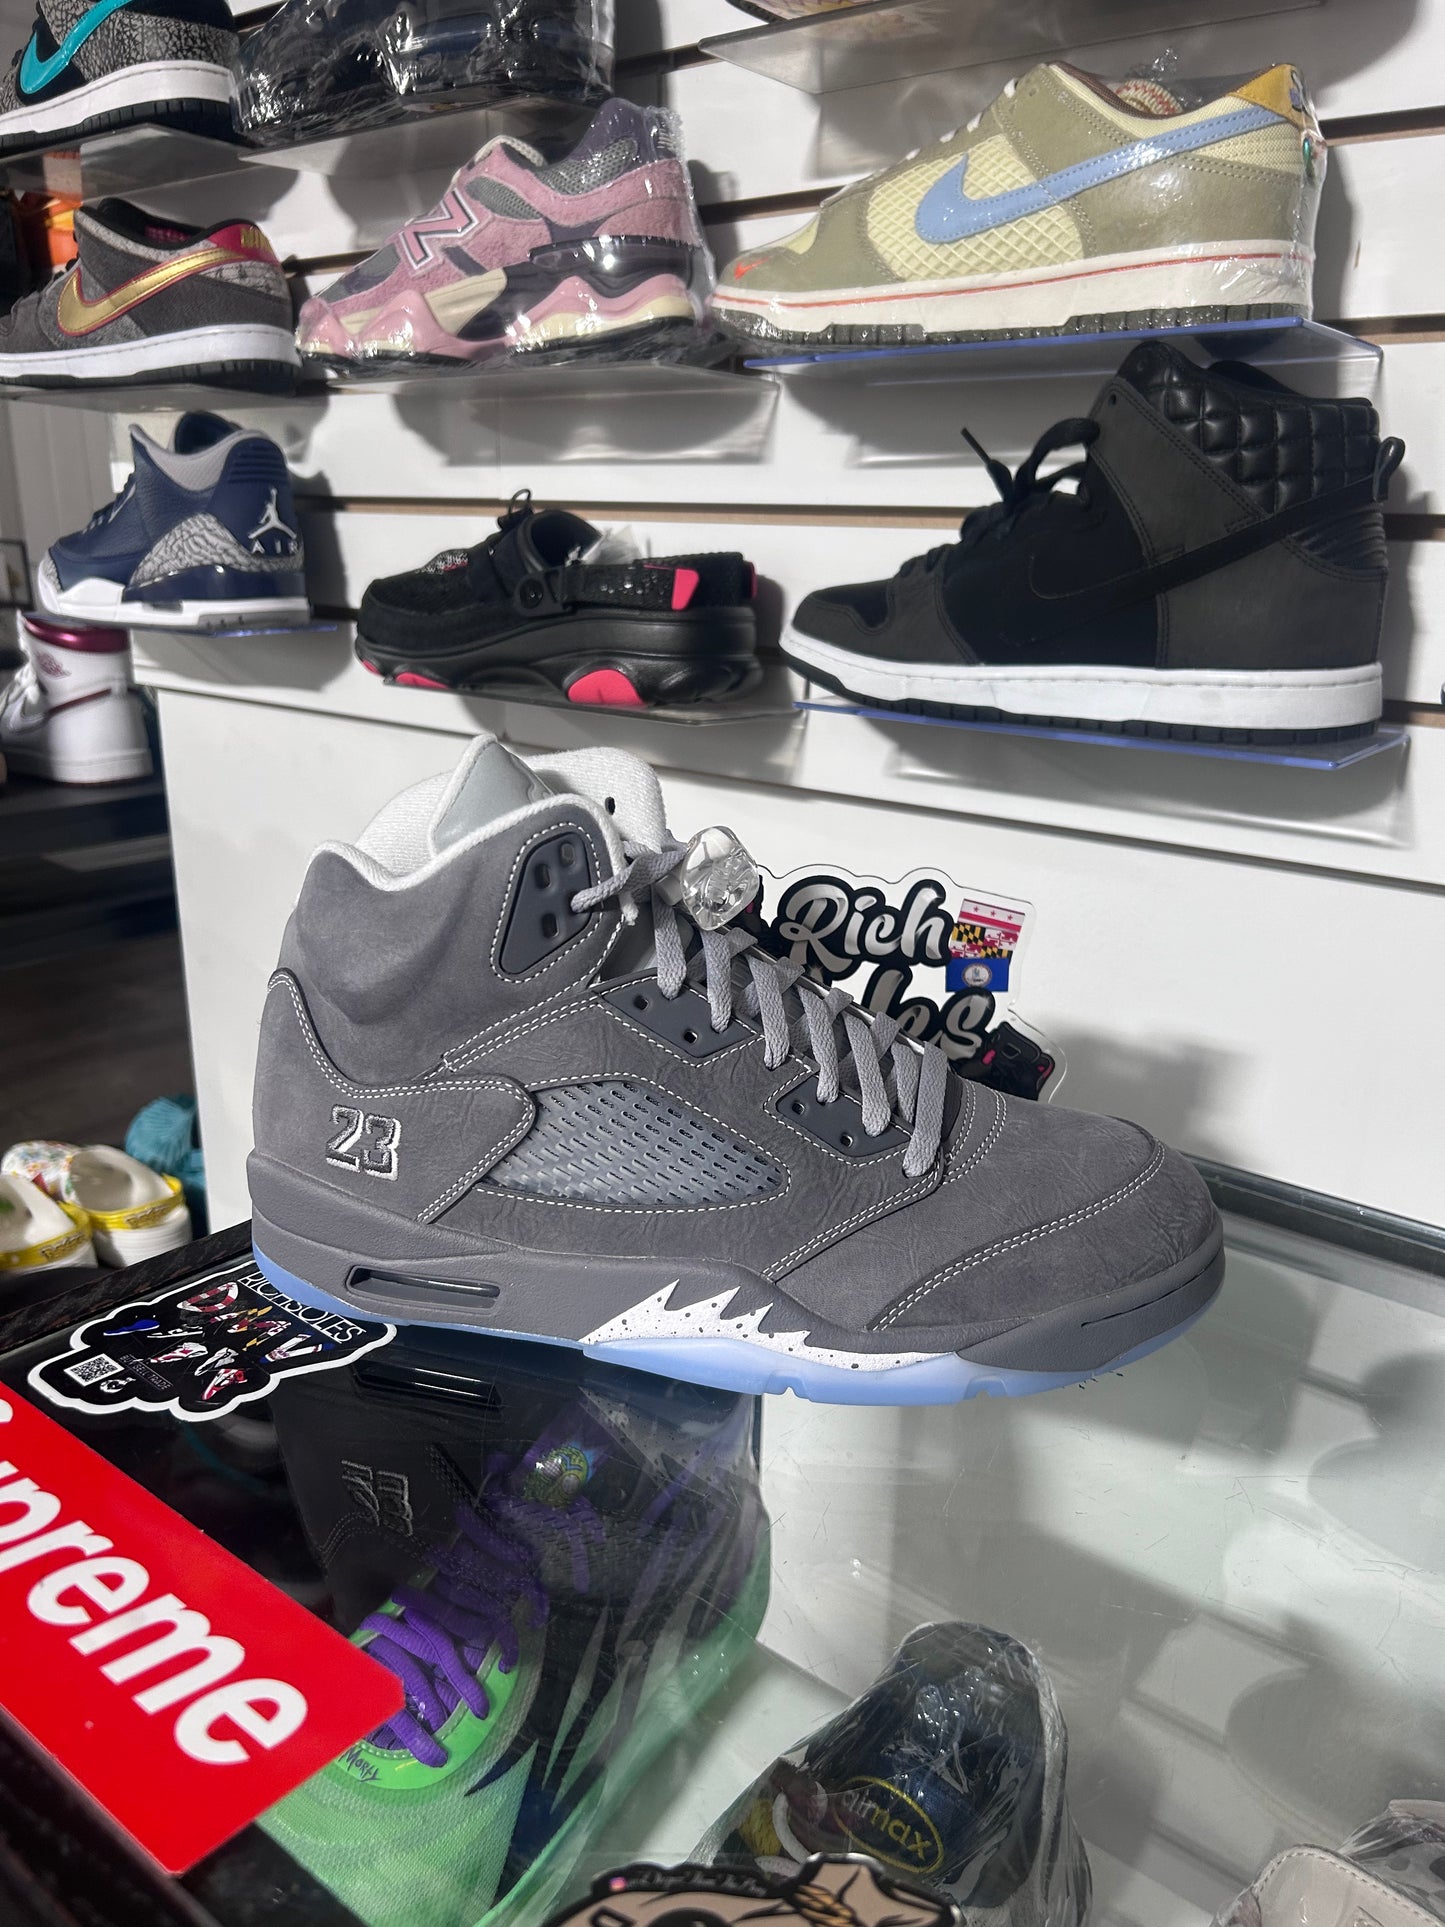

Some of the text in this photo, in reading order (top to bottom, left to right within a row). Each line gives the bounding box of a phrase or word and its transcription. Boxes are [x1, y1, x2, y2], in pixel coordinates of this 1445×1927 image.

[251, 539, 299, 554] AIR
[778, 883, 945, 973] Rich
[326, 1104, 401, 1181] 23
[0, 1398, 309, 1765] preme
